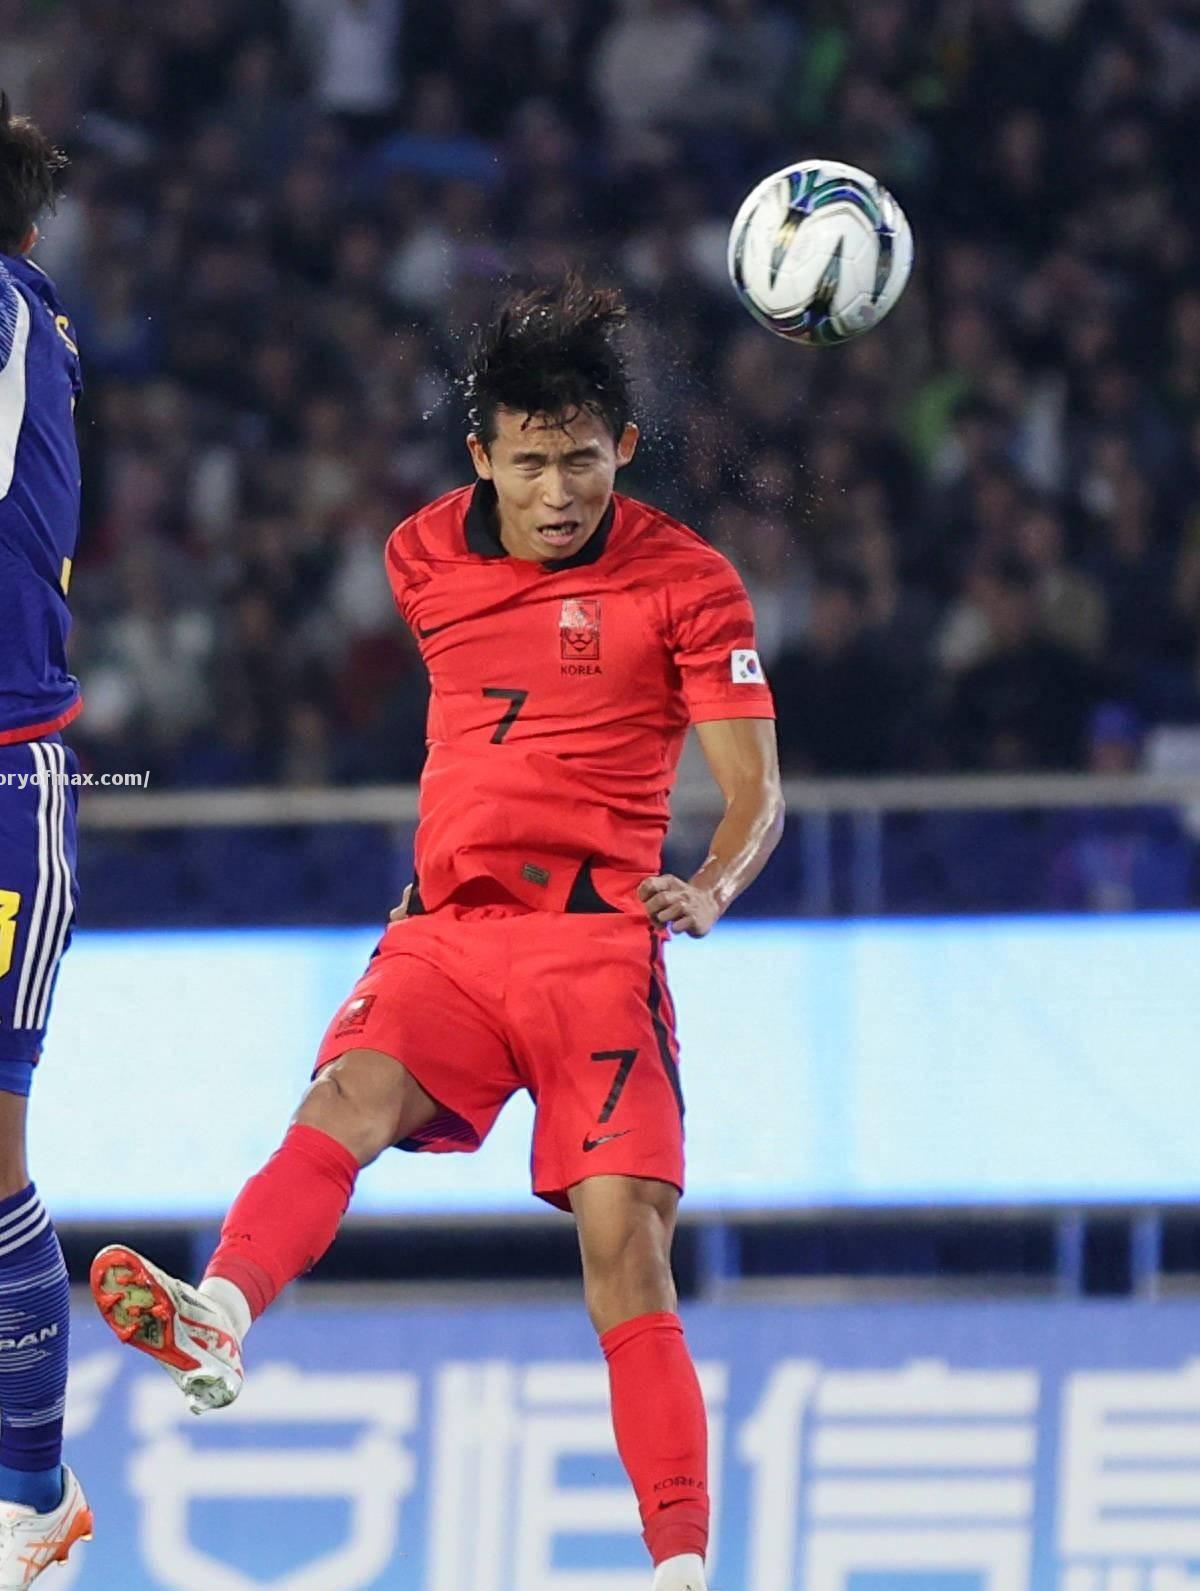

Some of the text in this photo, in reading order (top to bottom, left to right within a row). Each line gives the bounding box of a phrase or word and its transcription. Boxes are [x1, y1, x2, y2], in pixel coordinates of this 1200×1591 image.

[560, 664, 602, 676] KOREA
[482, 687, 529, 745] 7
[591, 1048, 640, 1124] 7
